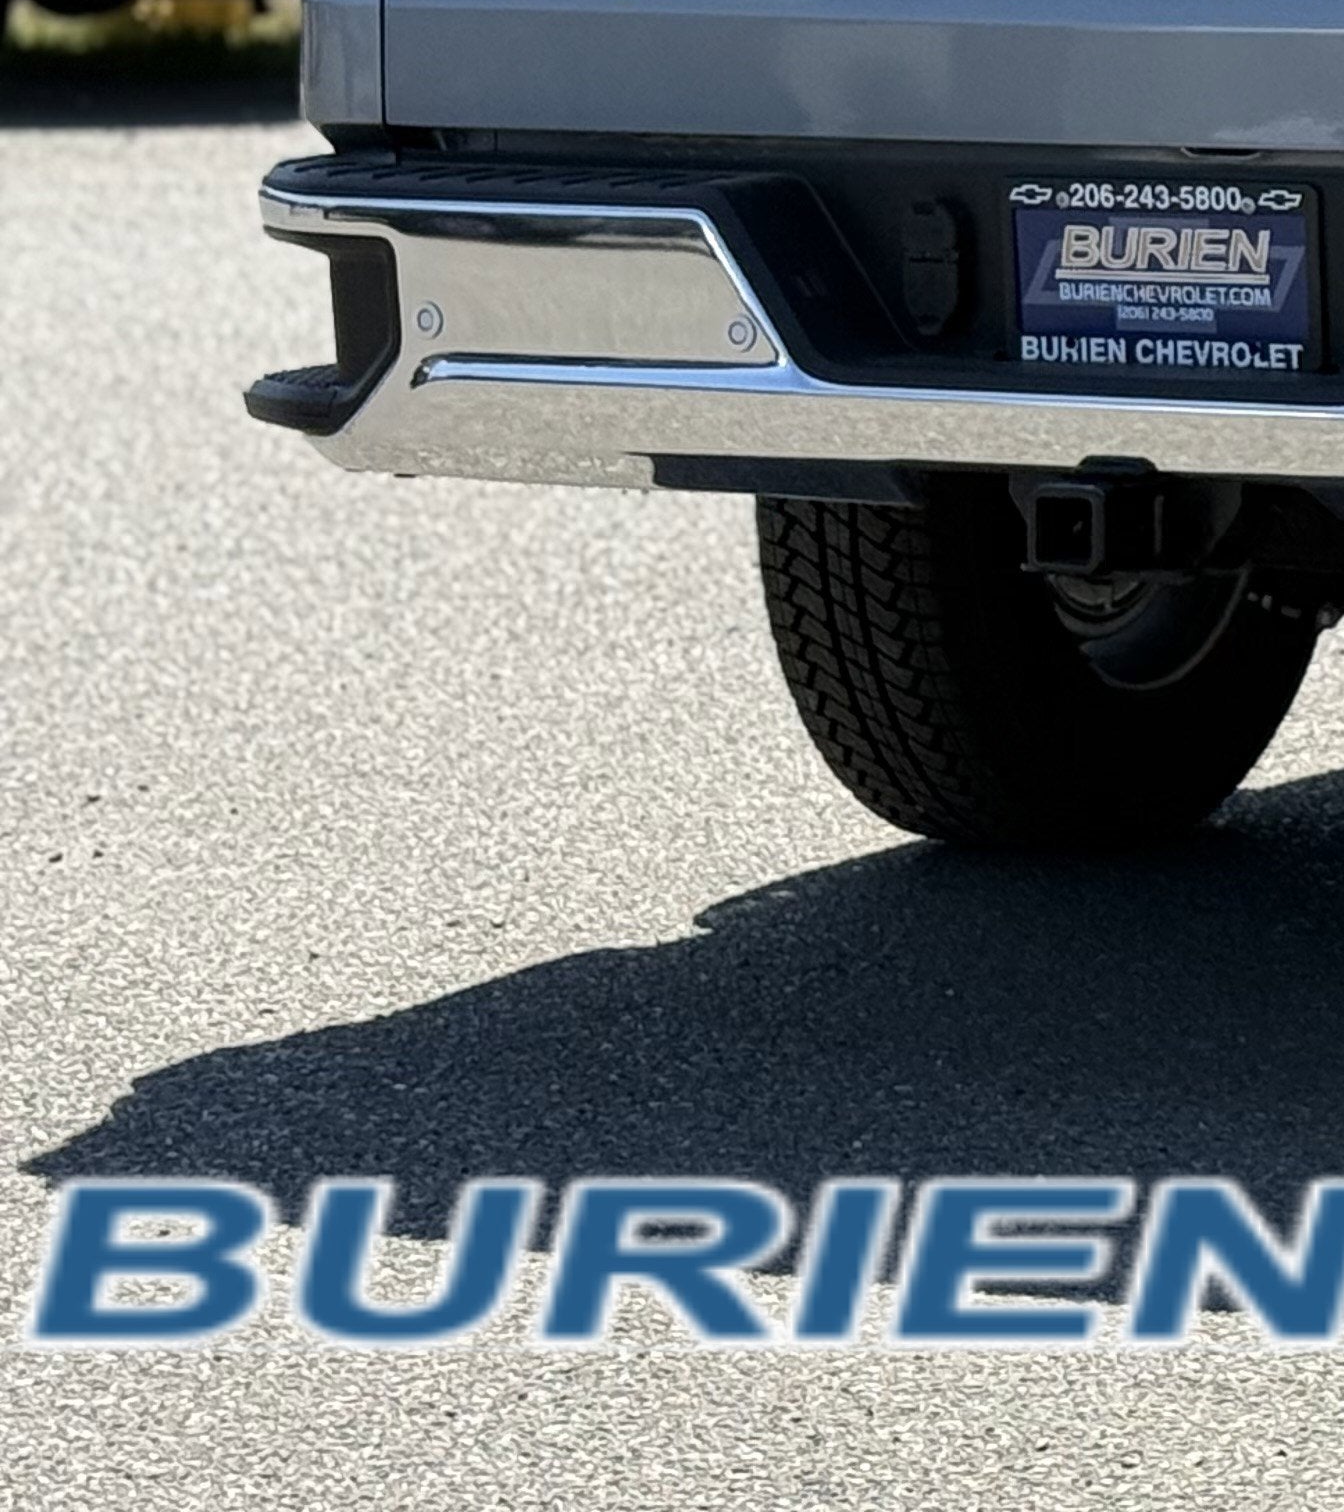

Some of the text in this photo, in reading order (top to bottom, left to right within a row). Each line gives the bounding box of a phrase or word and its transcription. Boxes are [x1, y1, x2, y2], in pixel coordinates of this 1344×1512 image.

[1068, 183, 1242, 212] 206-243-5800
[1060, 224, 1271, 274] BURIEN
[1058, 281, 1272, 307] BURIENCHEVROLET.COM
[1020, 335, 1304, 370] BURIEN CHEVROLET
